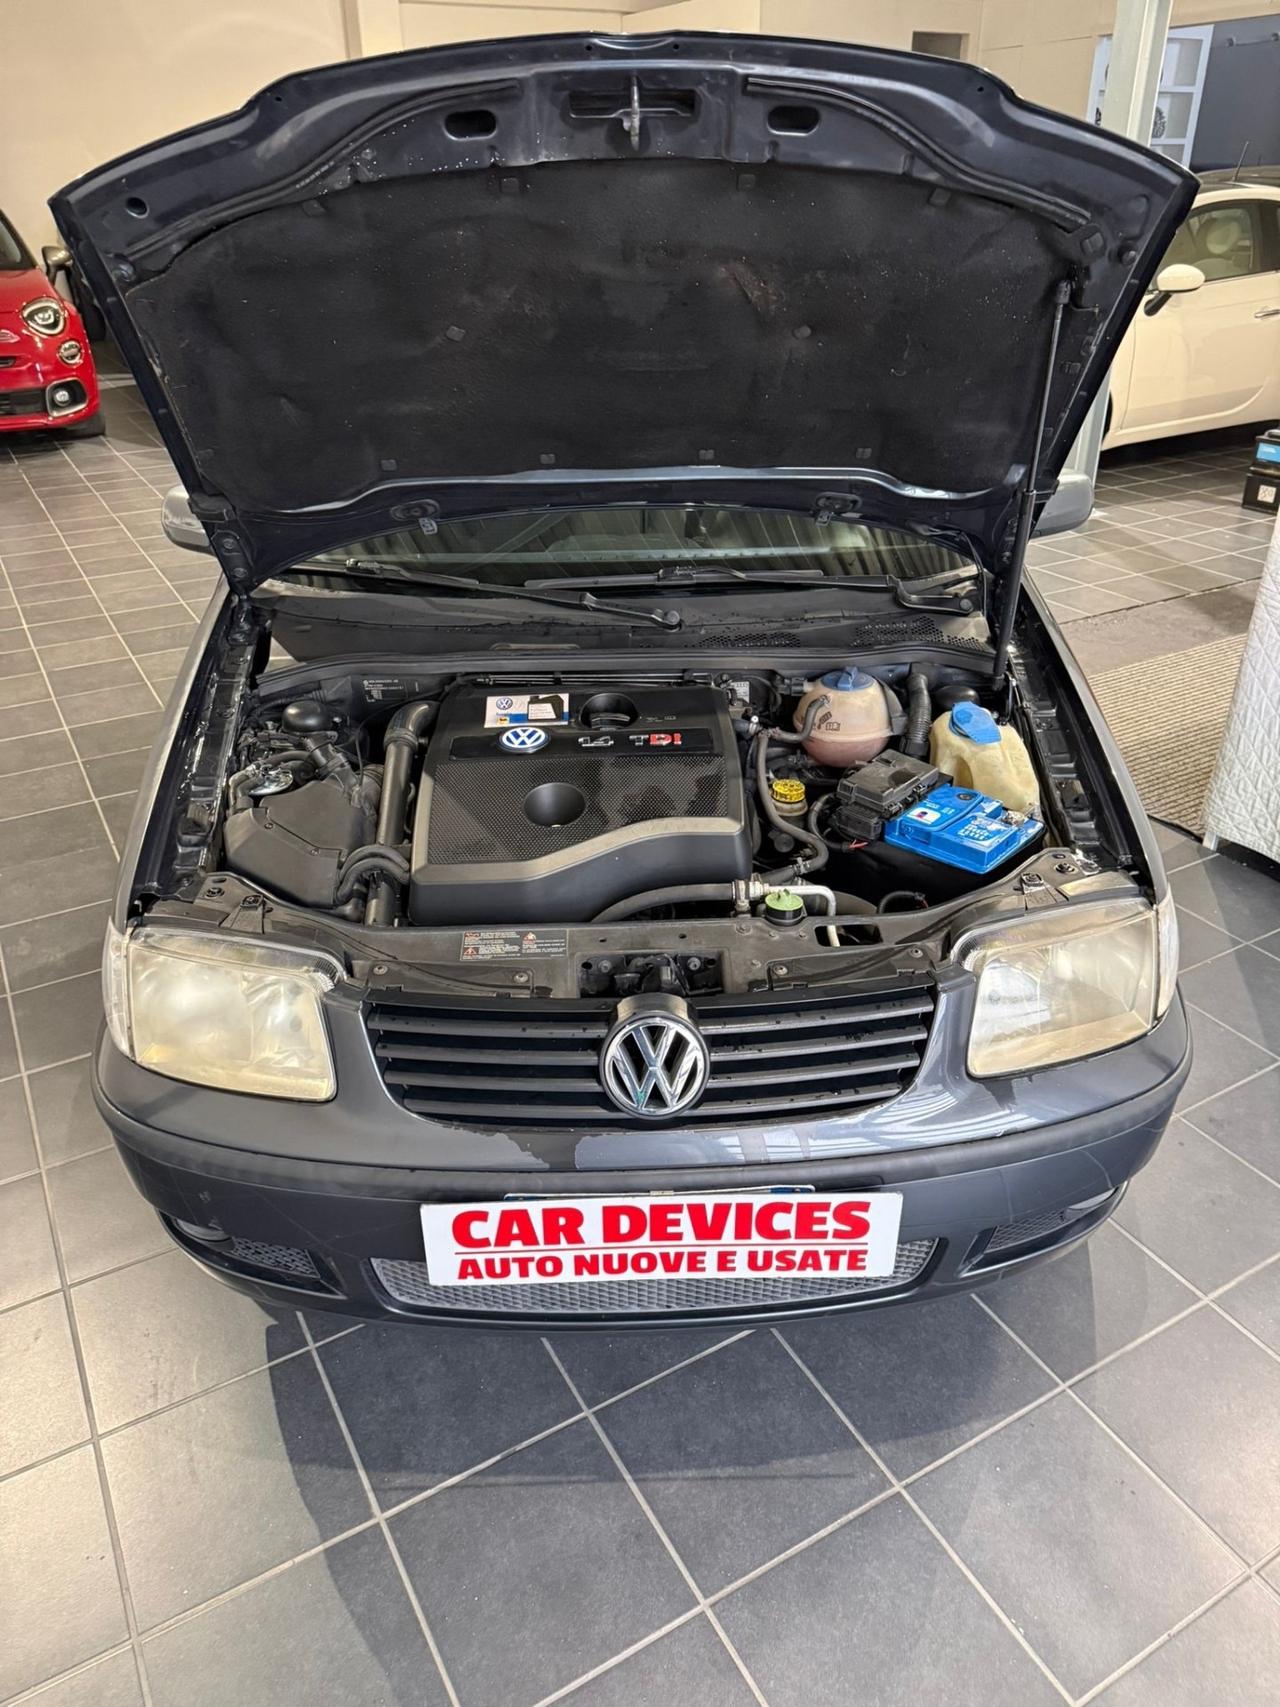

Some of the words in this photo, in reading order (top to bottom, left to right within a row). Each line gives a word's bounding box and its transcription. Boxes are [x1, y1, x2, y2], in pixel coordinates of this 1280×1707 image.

[629, 733, 682, 746] TDI
[602, 1014, 707, 1117] VW
[451, 1207, 584, 1249] CAR
[601, 1201, 871, 1244] DEVICES
[457, 1255, 563, 1281] AUTO
[573, 1251, 706, 1277] NUOVE
[716, 1250, 737, 1273] E
[747, 1249, 867, 1273] USATE
